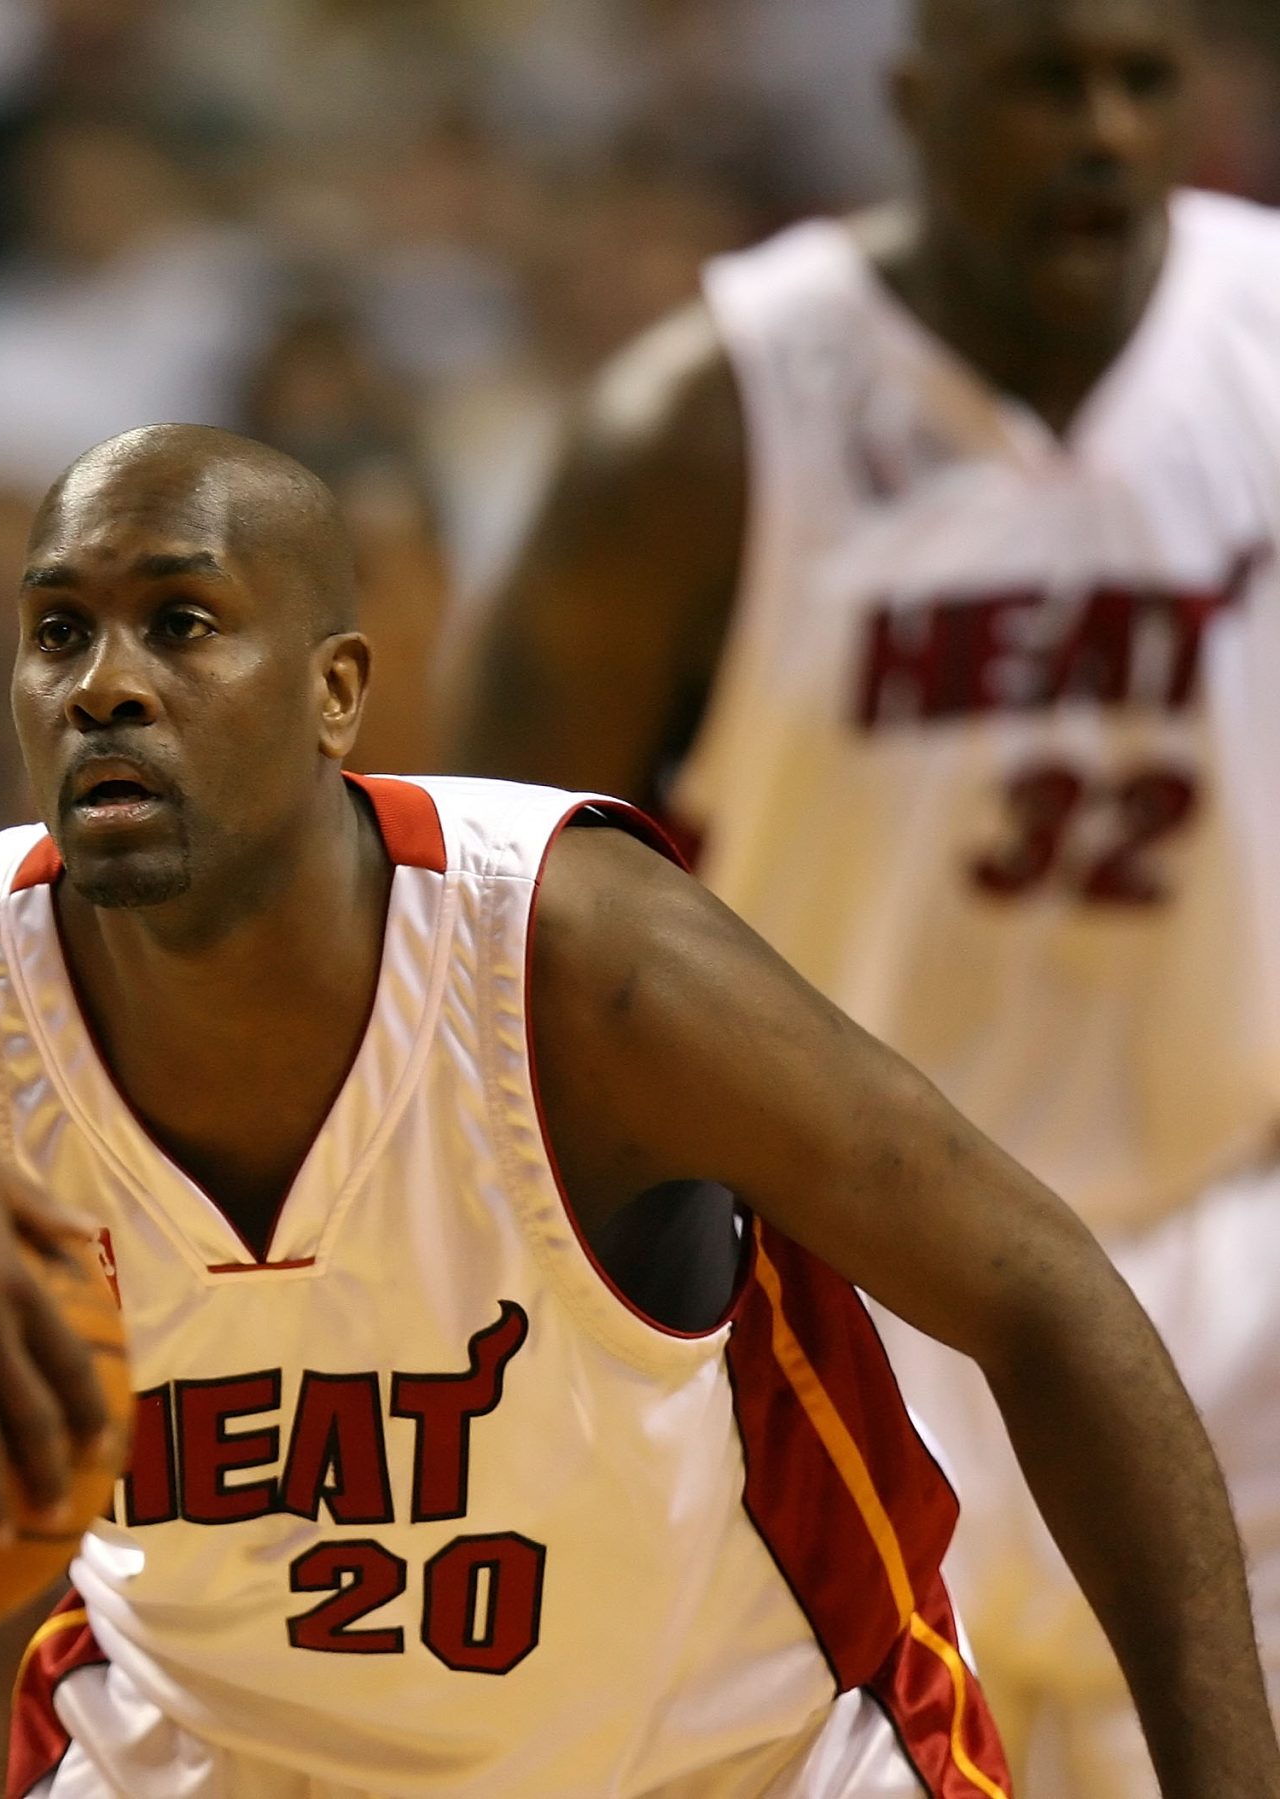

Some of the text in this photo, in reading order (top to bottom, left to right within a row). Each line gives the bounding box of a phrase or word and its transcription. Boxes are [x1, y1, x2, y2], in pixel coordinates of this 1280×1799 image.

[851, 537, 1276, 734] HEAT
[966, 763, 1200, 906] 32
[286, 1531, 547, 1675] 20
